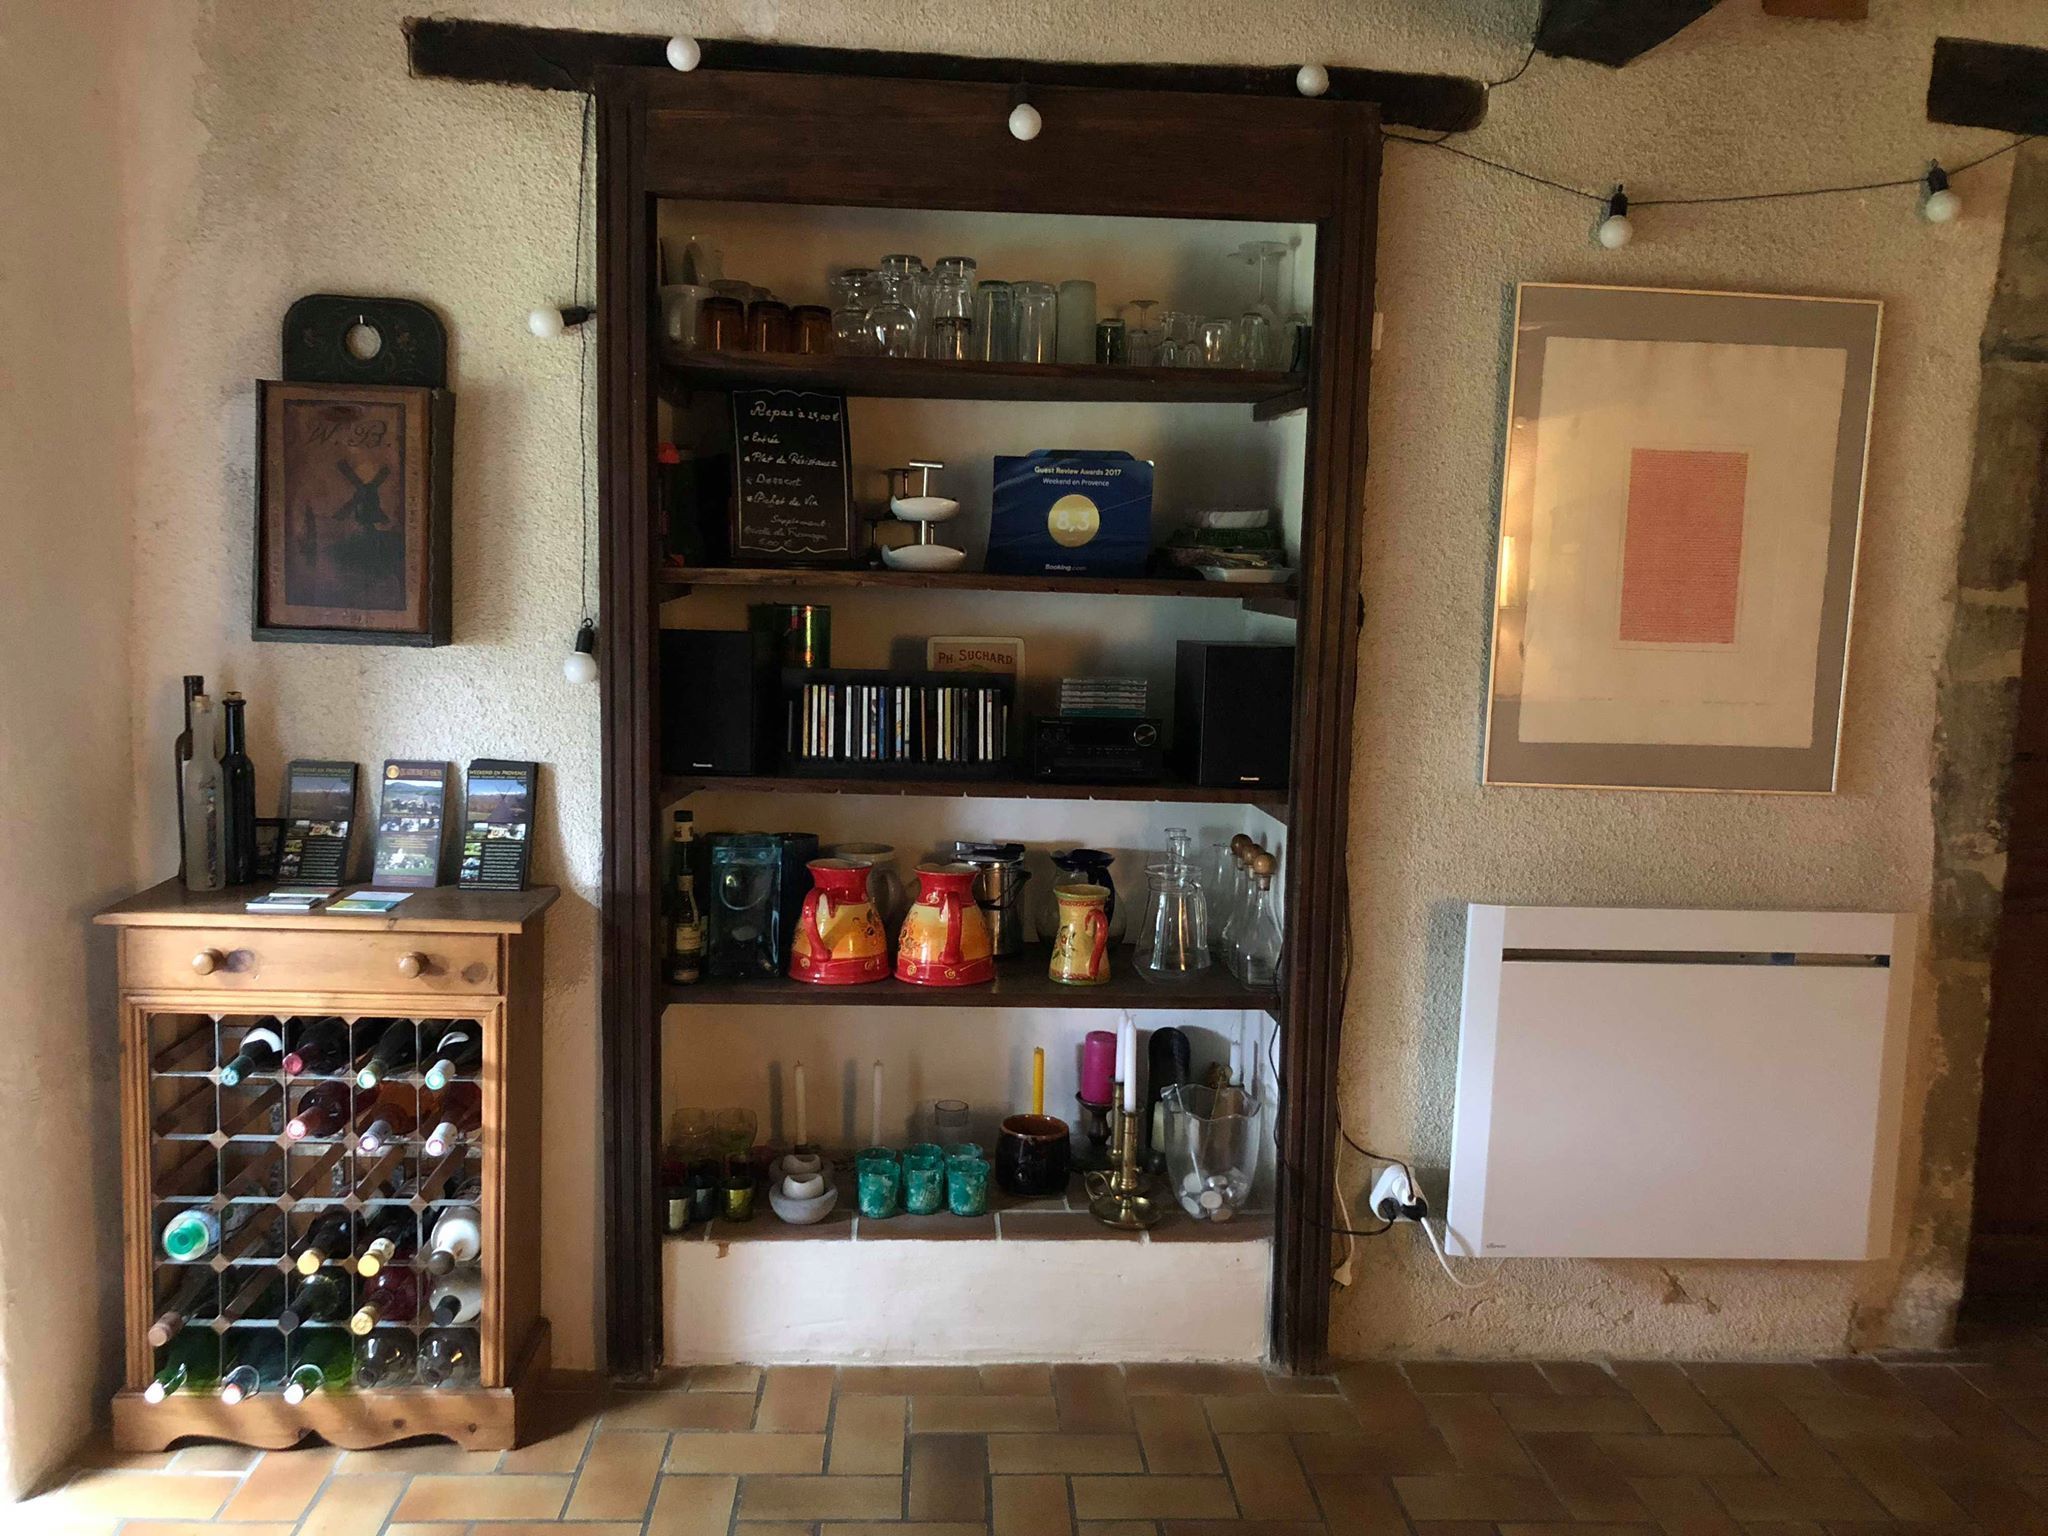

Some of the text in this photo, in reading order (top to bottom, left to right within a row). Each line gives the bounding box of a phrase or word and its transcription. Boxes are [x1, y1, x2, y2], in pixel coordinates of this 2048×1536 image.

[750, 400, 794, 423] Repas
[1034, 466, 1122, 477] Guest Review Awards 2017
[1043, 477, 1071, 486] Weekend
[1081, 478, 1110, 487] Provence
[1057, 510, 1090, 533] 8,3
[959, 649, 1013, 665] SUCHARD
